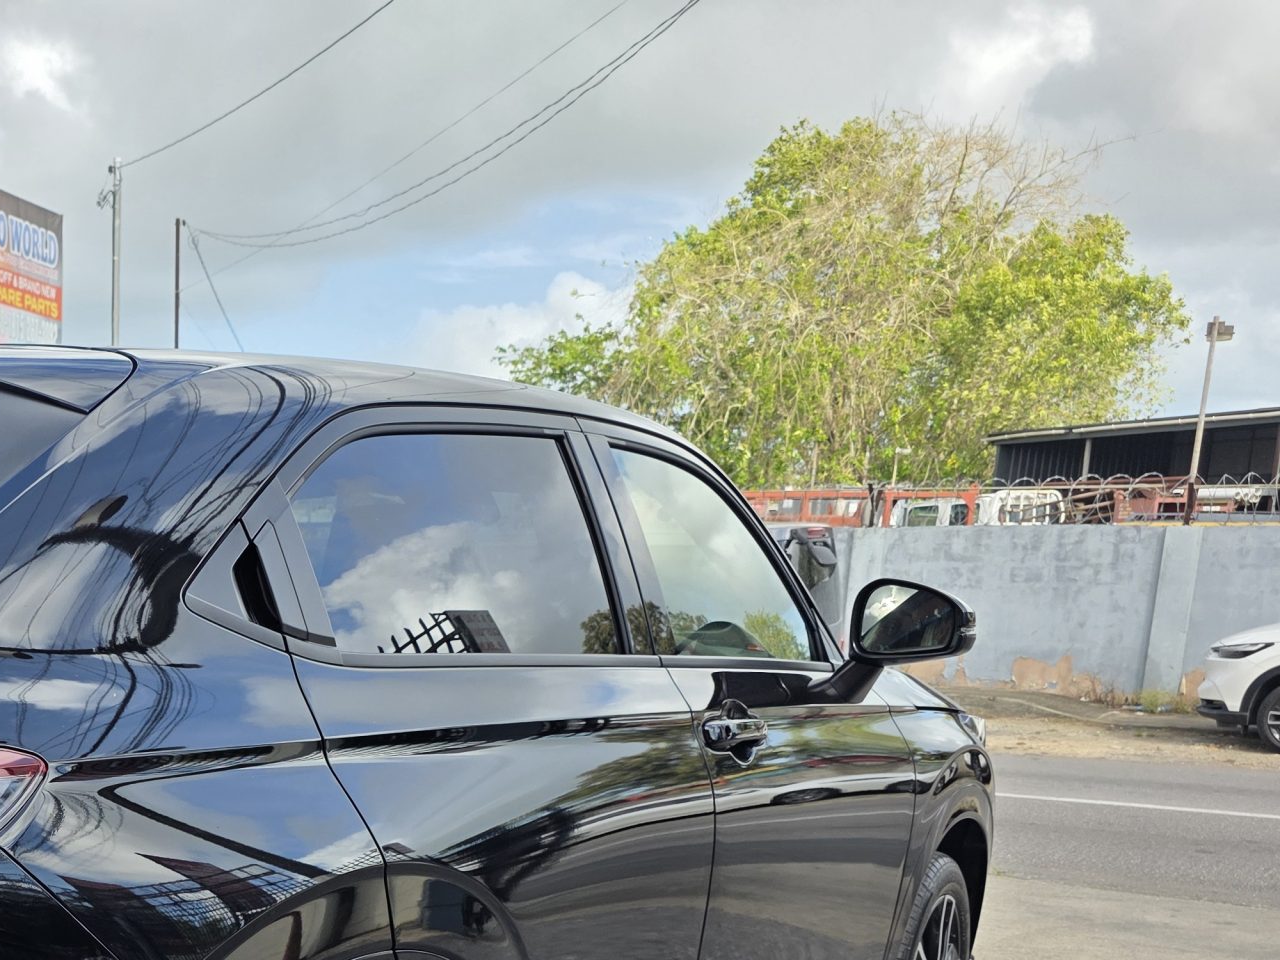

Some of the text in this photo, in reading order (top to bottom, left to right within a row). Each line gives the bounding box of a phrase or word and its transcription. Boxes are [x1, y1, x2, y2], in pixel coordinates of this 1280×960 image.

[9, 219, 58, 266] WORLD
[0, 268, 13, 285] OFF
[18, 275, 41, 295] BRAND
[41, 283, 57, 299] NEW
[24, 296, 58, 319] PARTS
